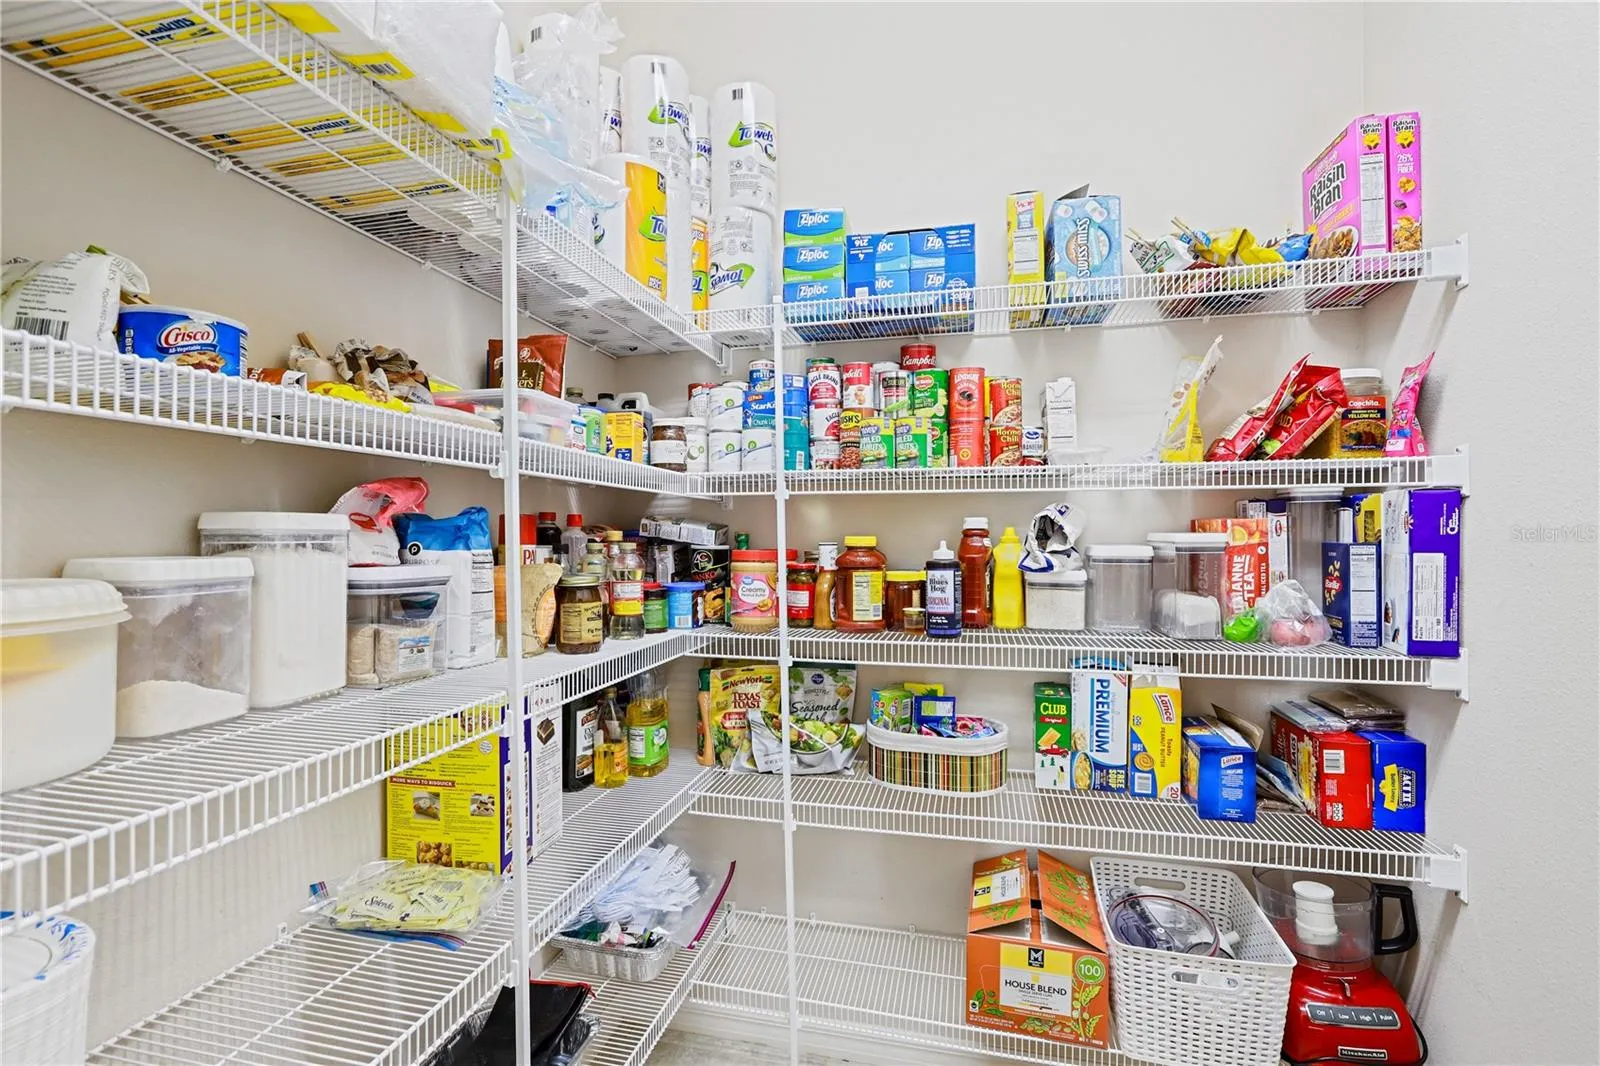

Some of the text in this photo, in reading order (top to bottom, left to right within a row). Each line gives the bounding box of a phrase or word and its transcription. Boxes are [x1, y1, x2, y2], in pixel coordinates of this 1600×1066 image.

[1360, 123, 1382, 131] Raisin
[739, 127, 774, 141] Towels
[1310, 163, 1345, 206] Raisin
[1313, 184, 1341, 220] Bran
[801, 212, 830, 226] Ziploc
[801, 249, 829, 262] Ziploc
[801, 286, 828, 298] Ziploc
[164, 327, 211, 346] Crisco
[823, 374, 839, 386] BRAND
[929, 577, 949, 585] Blues
[1244, 573, 1255, 600] TEA
[741, 586, 767, 595] Creamy
[930, 585, 947, 594] Hog
[732, 692, 760, 700] TEXAS
[732, 701, 760, 709] TOAST
[791, 699, 841, 712] Seasoned
[1040, 702, 1067, 715] CLUB
[1159, 695, 1173, 722] Lance
[1095, 679, 1110, 753] PREMIUM
[1116, 769, 1125, 789] FREE
[1402, 774, 1411, 791] ACT
[1170, 786, 1179, 799] 20
[1080, 964, 1101, 976] 100
[1005, 979, 1067, 996] HOUSE BLEND
